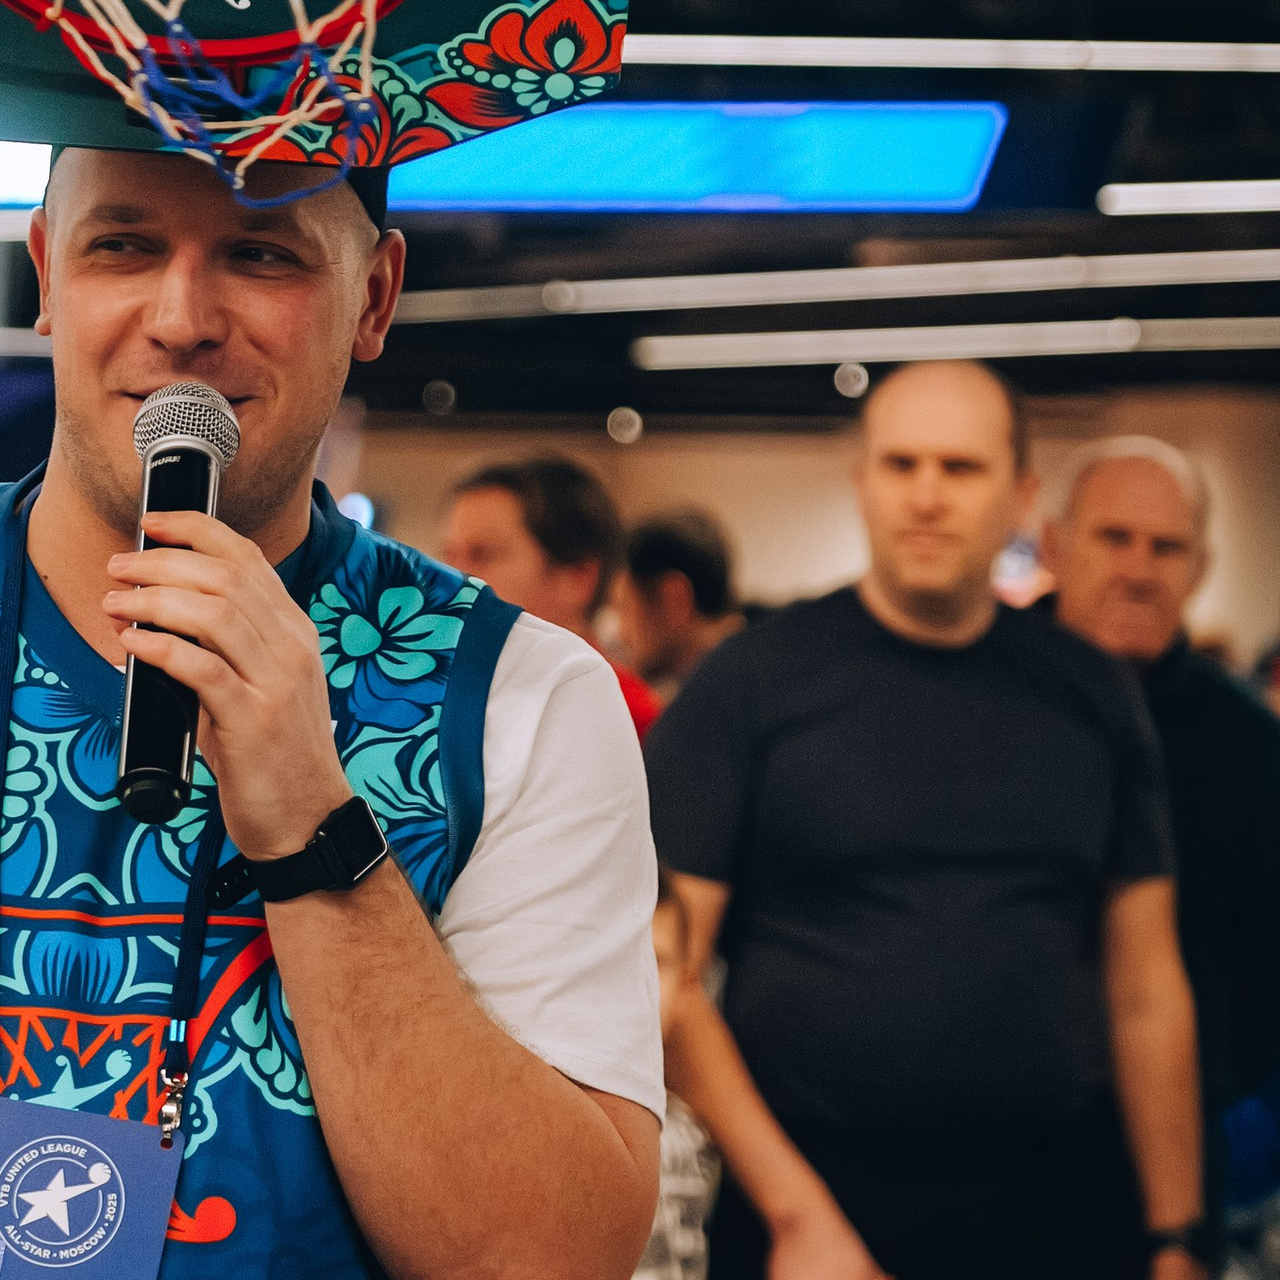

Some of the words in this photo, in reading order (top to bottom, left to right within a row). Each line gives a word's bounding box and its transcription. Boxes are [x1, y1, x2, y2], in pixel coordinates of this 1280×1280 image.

[40, 1143, 88, 1158] LEAGUE
[4, 1149, 39, 1183] UNITED
[0, 1184, 11, 1207] VTB
[4, 1224, 51, 1259] ALL-STAR
[59, 1227, 107, 1260] MOSCOW
[104, 1193, 117, 1221] 2025
